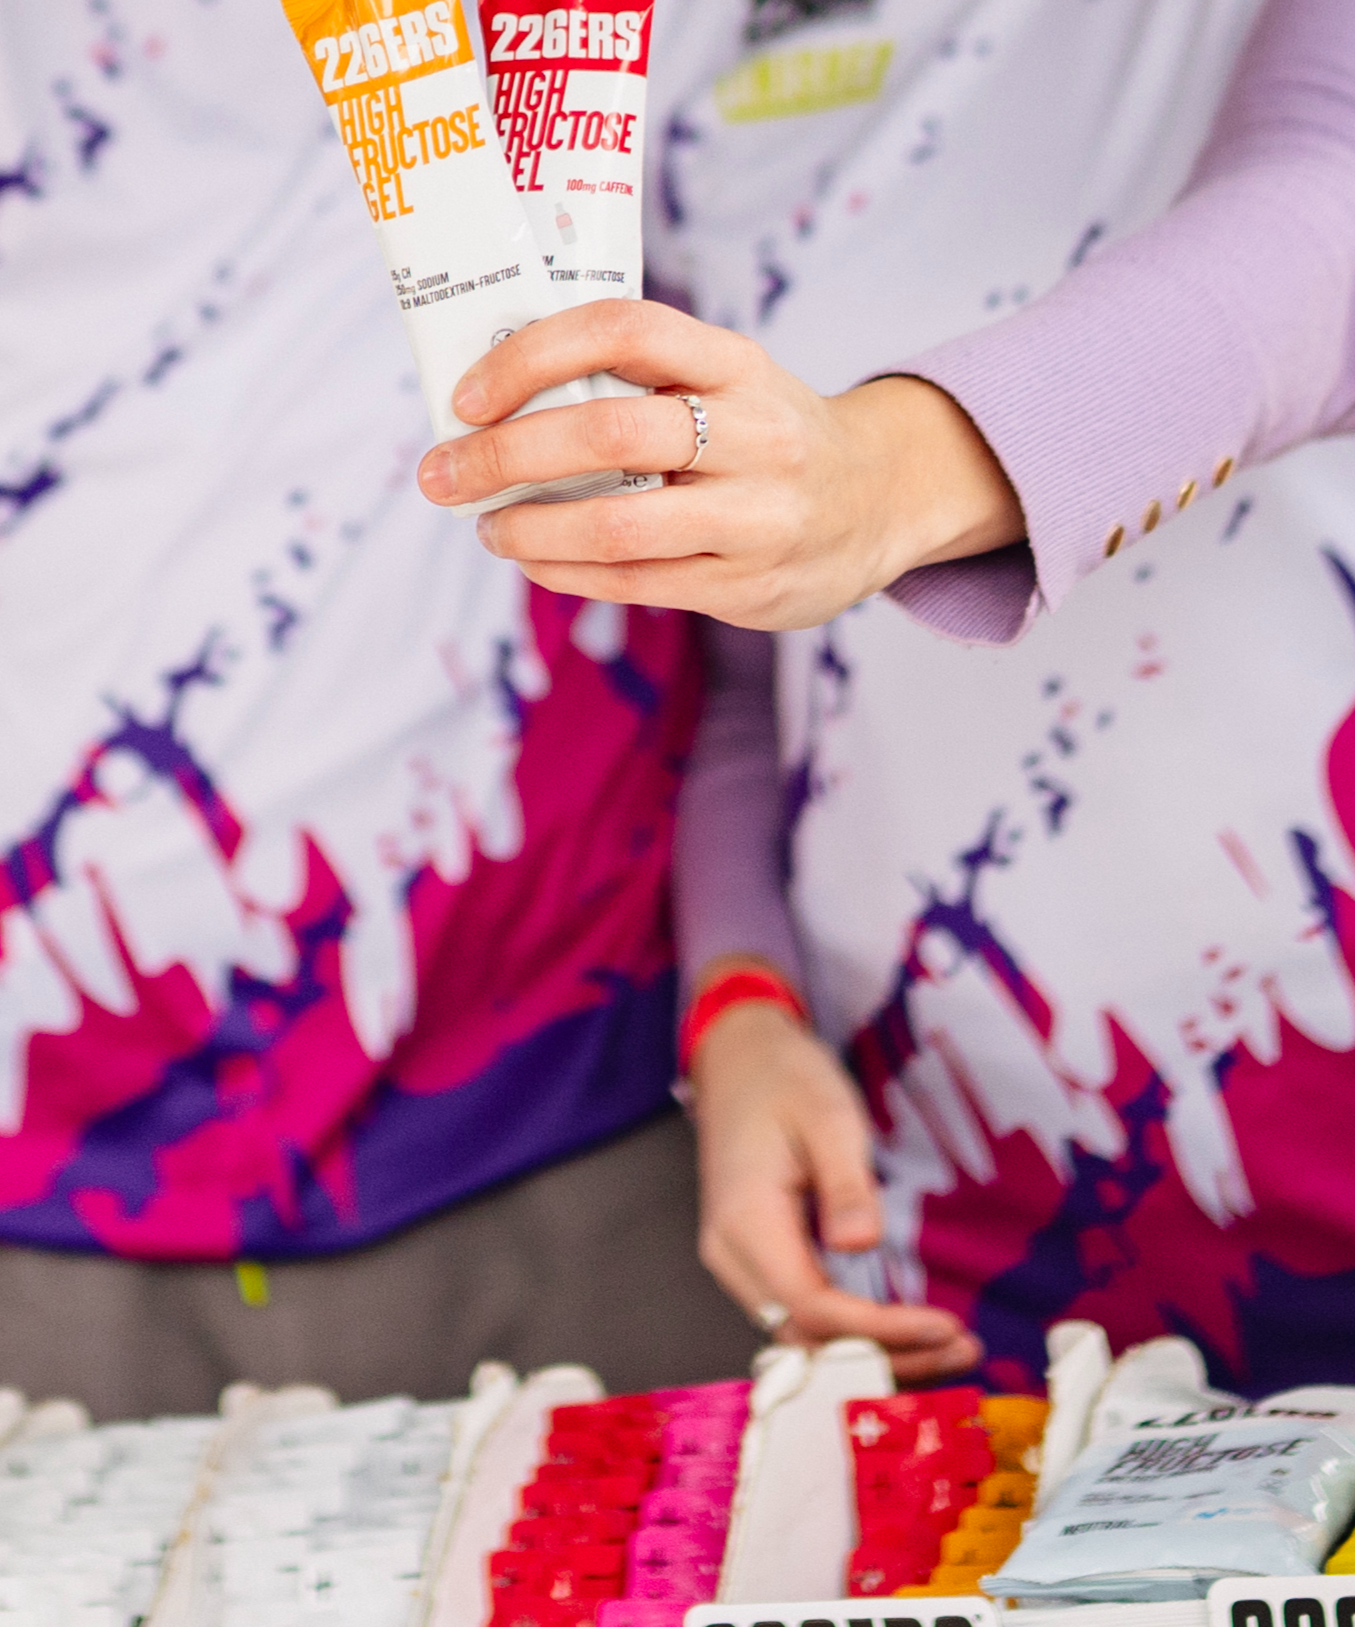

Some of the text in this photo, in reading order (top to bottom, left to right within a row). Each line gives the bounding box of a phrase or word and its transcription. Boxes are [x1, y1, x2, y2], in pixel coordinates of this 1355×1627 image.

[315, 0, 459, 93] 226ERS
[490, 8, 642, 63] 226ERS
[338, 83, 406, 146] HIGH
[493, 70, 570, 115] HIGH
[347, 103, 486, 186] FRUCTOSE
[497, 111, 637, 155] FRUCTOSE
[359, 173, 414, 223] GEL
[566, 179, 597, 194] 100mg
[417, 272, 450, 291] SODIUM
